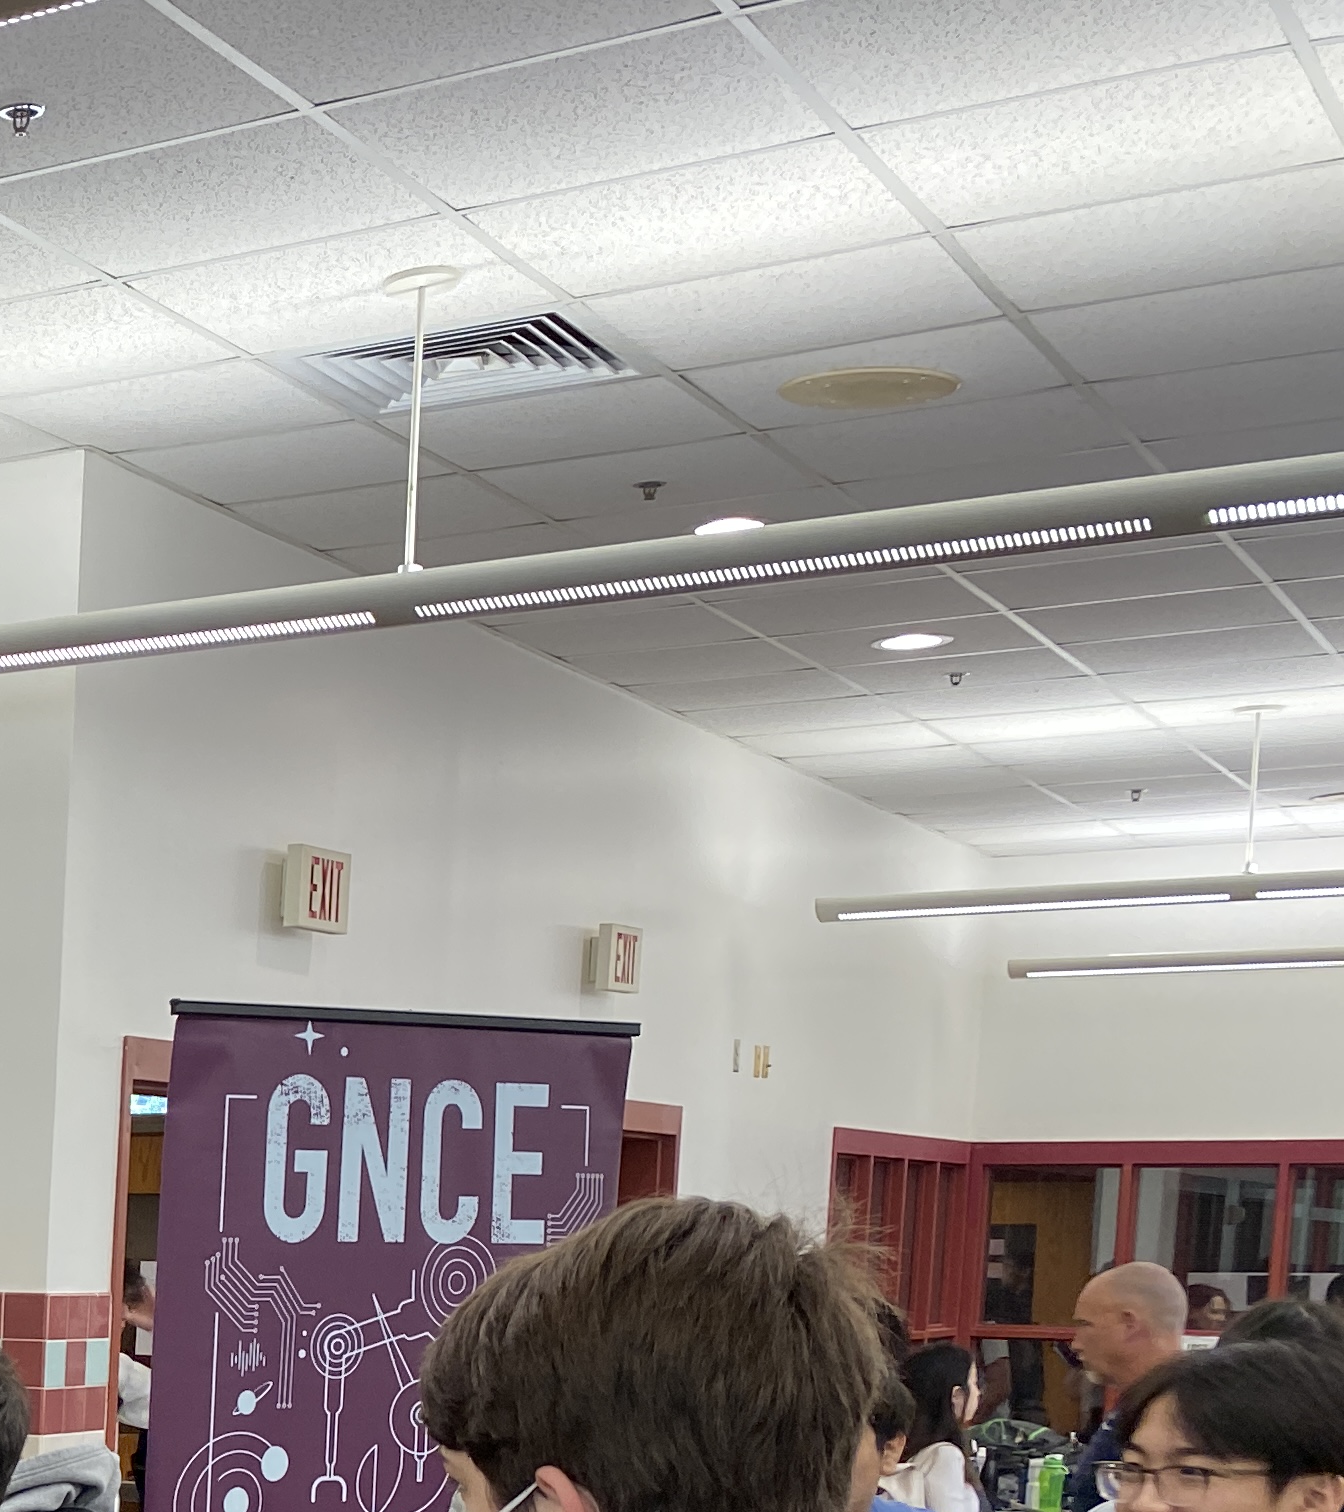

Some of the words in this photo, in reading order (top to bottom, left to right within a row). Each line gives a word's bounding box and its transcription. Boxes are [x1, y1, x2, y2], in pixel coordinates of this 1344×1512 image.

[308, 855, 344, 923] EXIT
[615, 932, 638, 985] EXIT
[264, 1073, 551, 1244] GNCE
